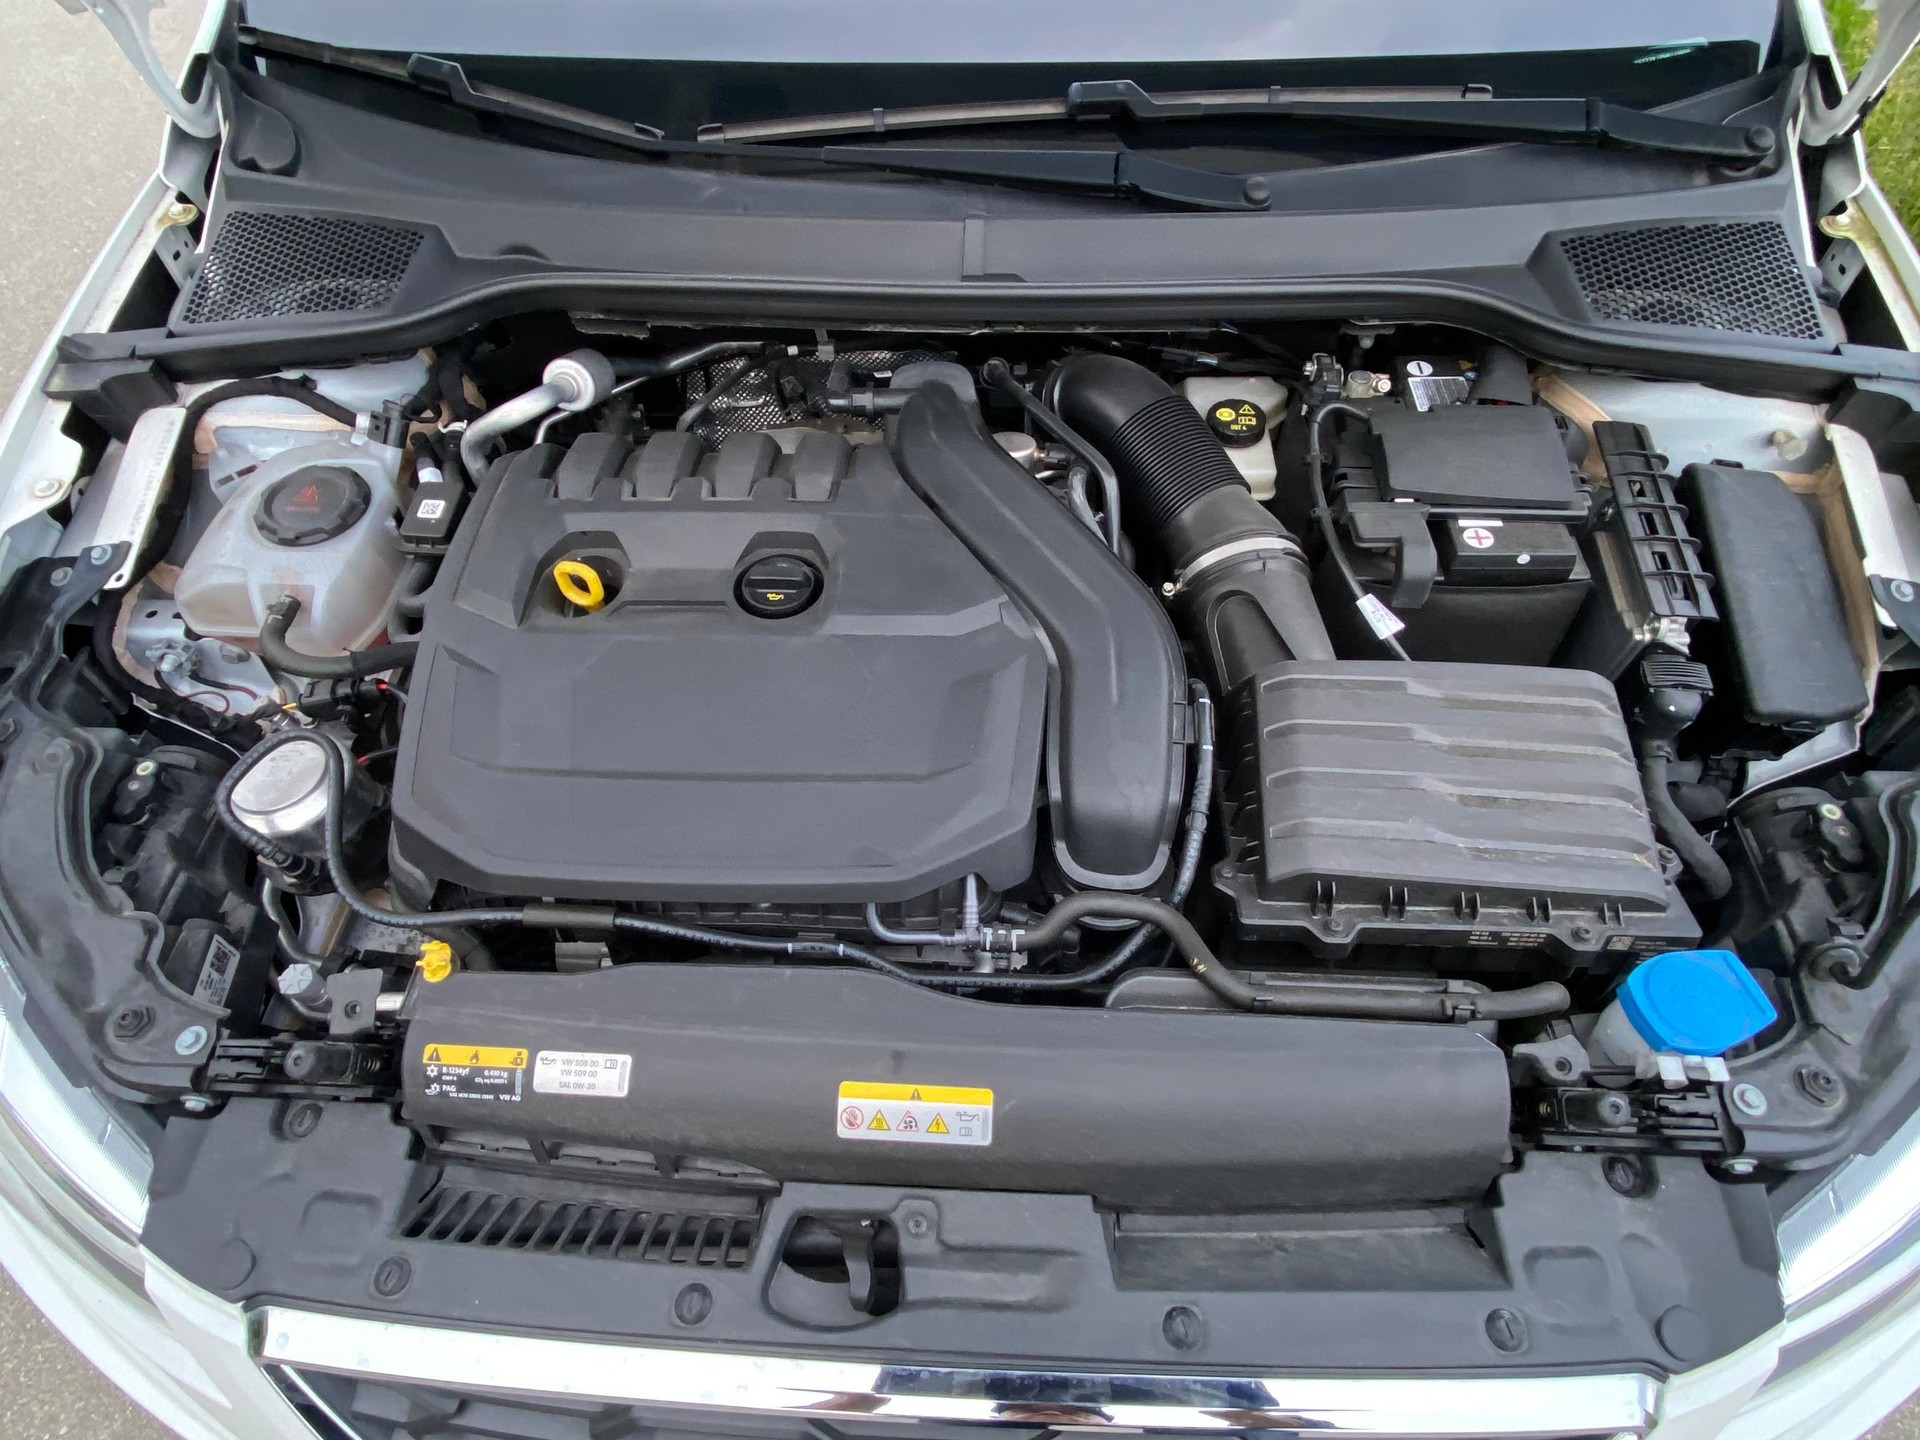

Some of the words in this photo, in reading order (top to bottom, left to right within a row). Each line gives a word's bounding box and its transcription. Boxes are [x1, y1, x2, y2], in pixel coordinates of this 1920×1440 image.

[575, 1059, 588, 1067] 508
[589, 1060, 599, 1068] 00
[442, 1066, 470, 1077] R-1234yf
[500, 1070, 509, 1079] kg
[573, 1069, 587, 1077] 509
[588, 1070, 598, 1078] 00
[442, 1084, 456, 1092] PAG
[559, 1081, 571, 1089] SAE
[572, 1082, 596, 1090] 0W-20
[511, 1094, 521, 1102] AG
